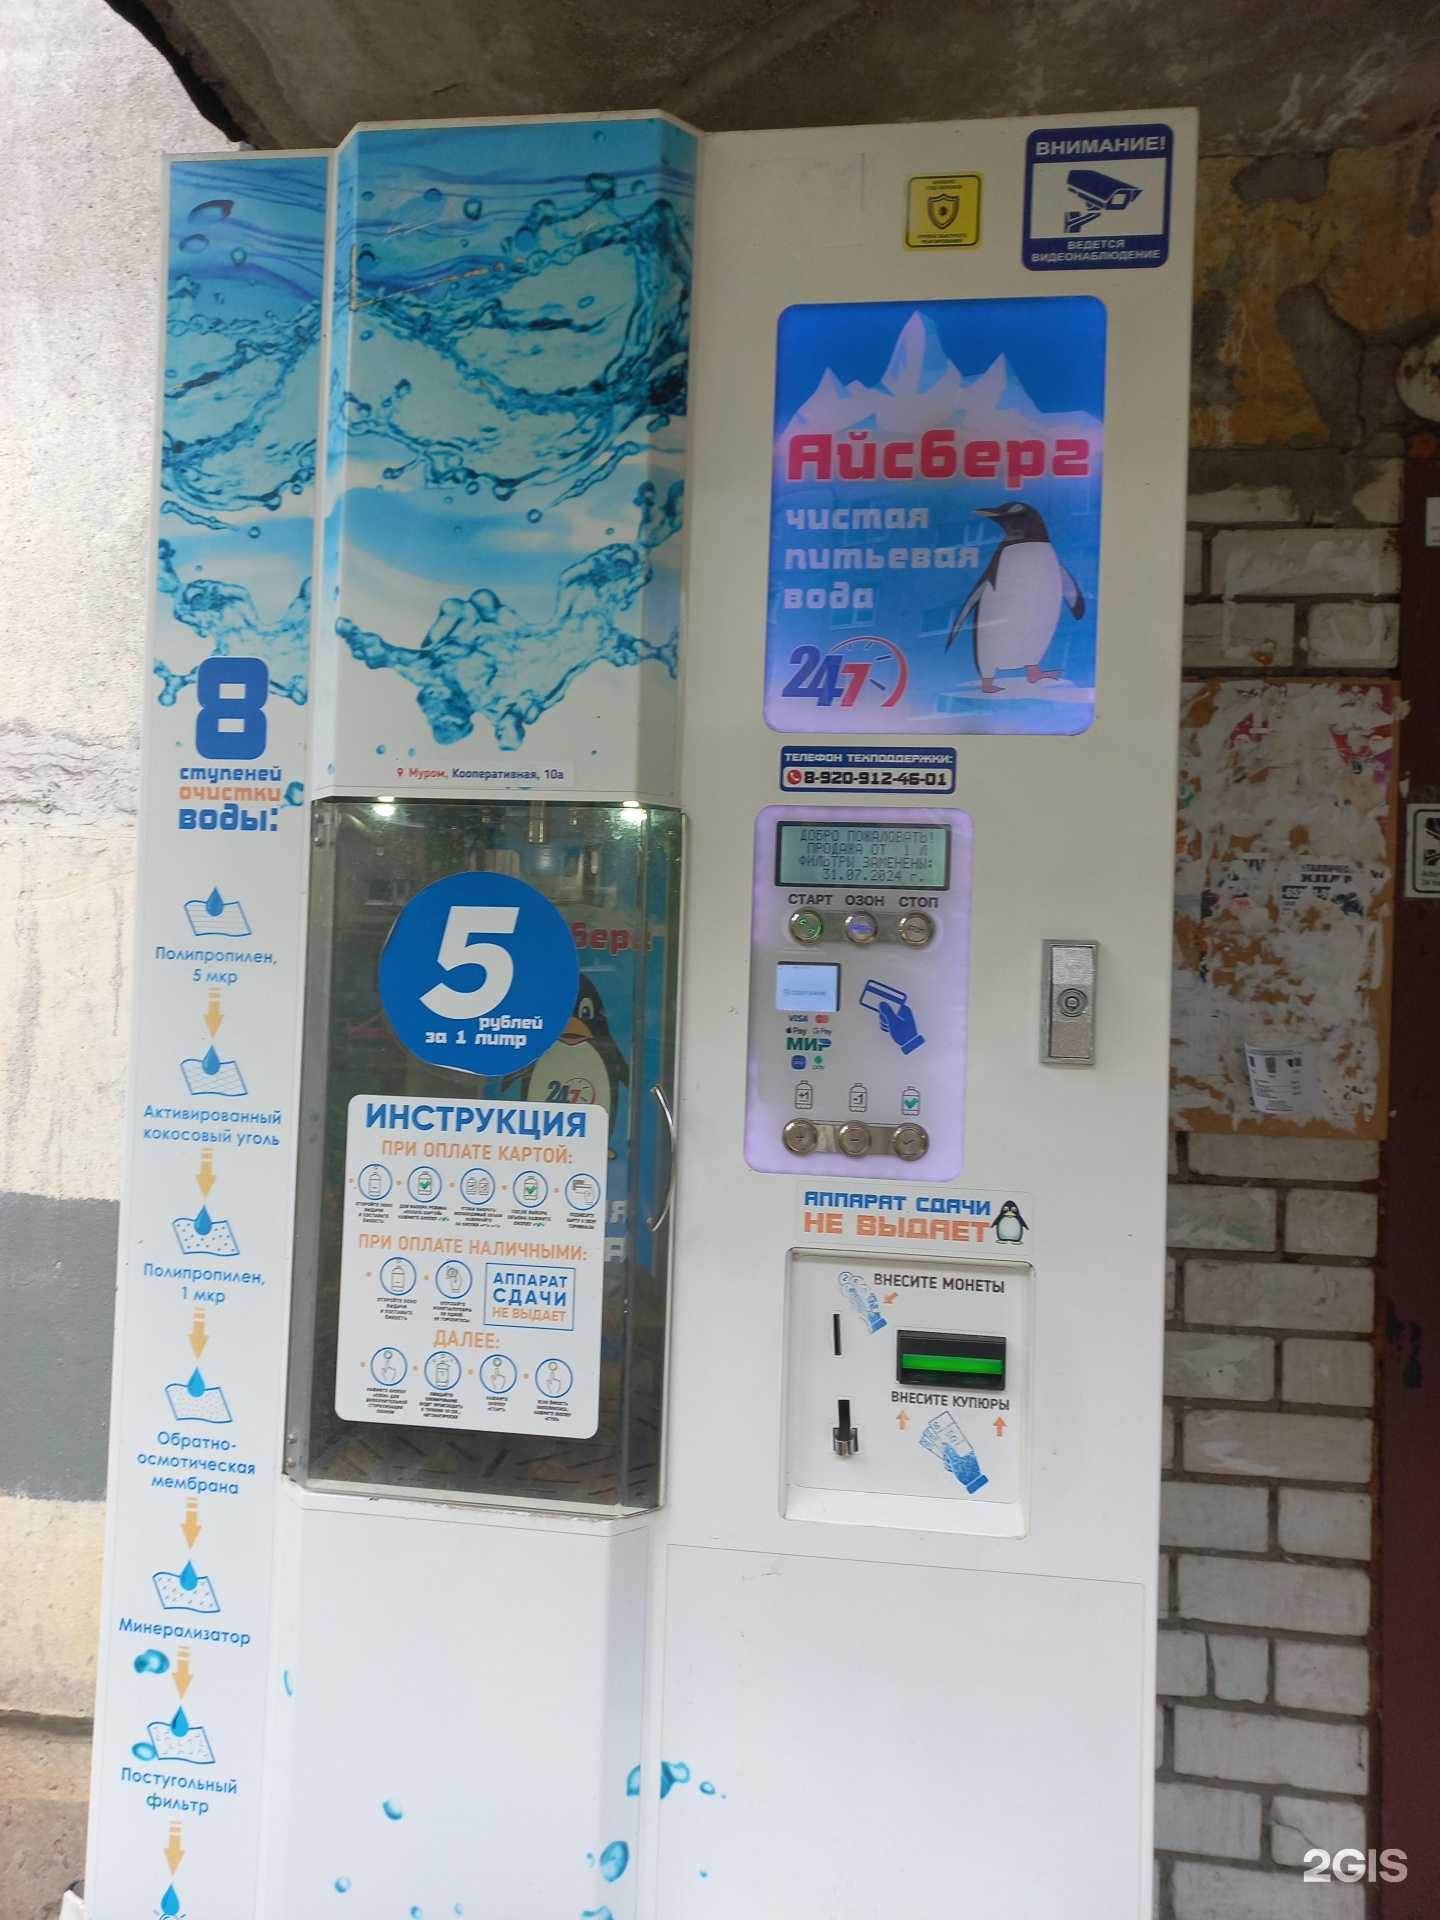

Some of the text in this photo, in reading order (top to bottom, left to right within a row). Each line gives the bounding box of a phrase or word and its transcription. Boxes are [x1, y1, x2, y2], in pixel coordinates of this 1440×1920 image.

[1035, 136, 1166, 156] ВНИМАНИЕ!
[1067, 239, 1125, 250] ВЕДЕТСЯ
[1031, 249, 1160, 263] ВИДЕОНАБЛЮДЕНИЕ
[786, 429, 1090, 488] Айсберг
[786, 507, 929, 530] чистая
[784, 545, 979, 570] питьевая
[784, 583, 874, 609] вода
[195, 656, 269, 761] 8
[784, 753, 953, 764] ТЕЛЕФОН ТЕХПОДДЕРЖКИ:
[180, 766, 281, 783] ступеней
[452, 768, 540, 782] Кооперативная,
[804, 771, 946, 786] 8-920-912-46-01
[180, 786, 281, 803] очистки
[178, 803, 279, 832] воды:
[800, 829, 839, 841] ДОБРО
[788, 894, 832, 905] СТАРТ
[845, 895, 885, 906] ОЗОН
[898, 896, 938, 908] СТОП
[156, 946, 277, 966] Полипропилен,
[419, 905, 520, 1019] 5
[192, 969, 238, 985] 5 мкр
[479, 1016, 543, 1032] рублей
[425, 1031, 527, 1049] за 1 литр
[787, 1037, 832, 1051] МИР
[144, 1105, 282, 1125] Активированный
[365, 1103, 587, 1140] ИНСТРУКЦИЯ
[144, 1128, 280, 1147] кокосовый уголь
[382, 1140, 573, 1164] ПРИ ОПЛАТЕ КАРТОЙ:
[804, 1190, 991, 1216] АППАРАТ СДАЧИ
[804, 1212, 991, 1242] НЕ ВЫДАЕТ
[359, 1233, 391, 1249] ПРИ
[399, 1235, 462, 1254] ОПЛАТЕ
[469, 1240, 587, 1261] НАЛИЧНЫМИ:
[144, 1263, 265, 1286] Полипропилен,
[493, 1272, 568, 1288] АППАРАТ
[874, 1273, 1005, 1293] ВНЕСИТЕ МОНЕТЫ
[181, 1286, 226, 1304] 1 мкр
[492, 1288, 567, 1307] СДАЧИ
[492, 1307, 567, 1323] НЕ ВЫДАЕТ
[433, 1330, 501, 1349] ДАЛЕЕ:
[891, 1391, 1010, 1411] ВНЕСИТЕ КУПЮРЫ
[157, 1431, 236, 1452] Обратно-
[137, 1452, 256, 1475] осмотическая
[151, 1475, 239, 1495] мембрана
[119, 1617, 251, 1647] Минерализатор
[121, 1767, 238, 1795] Постугольный
[146, 1793, 209, 1816] фильтр
